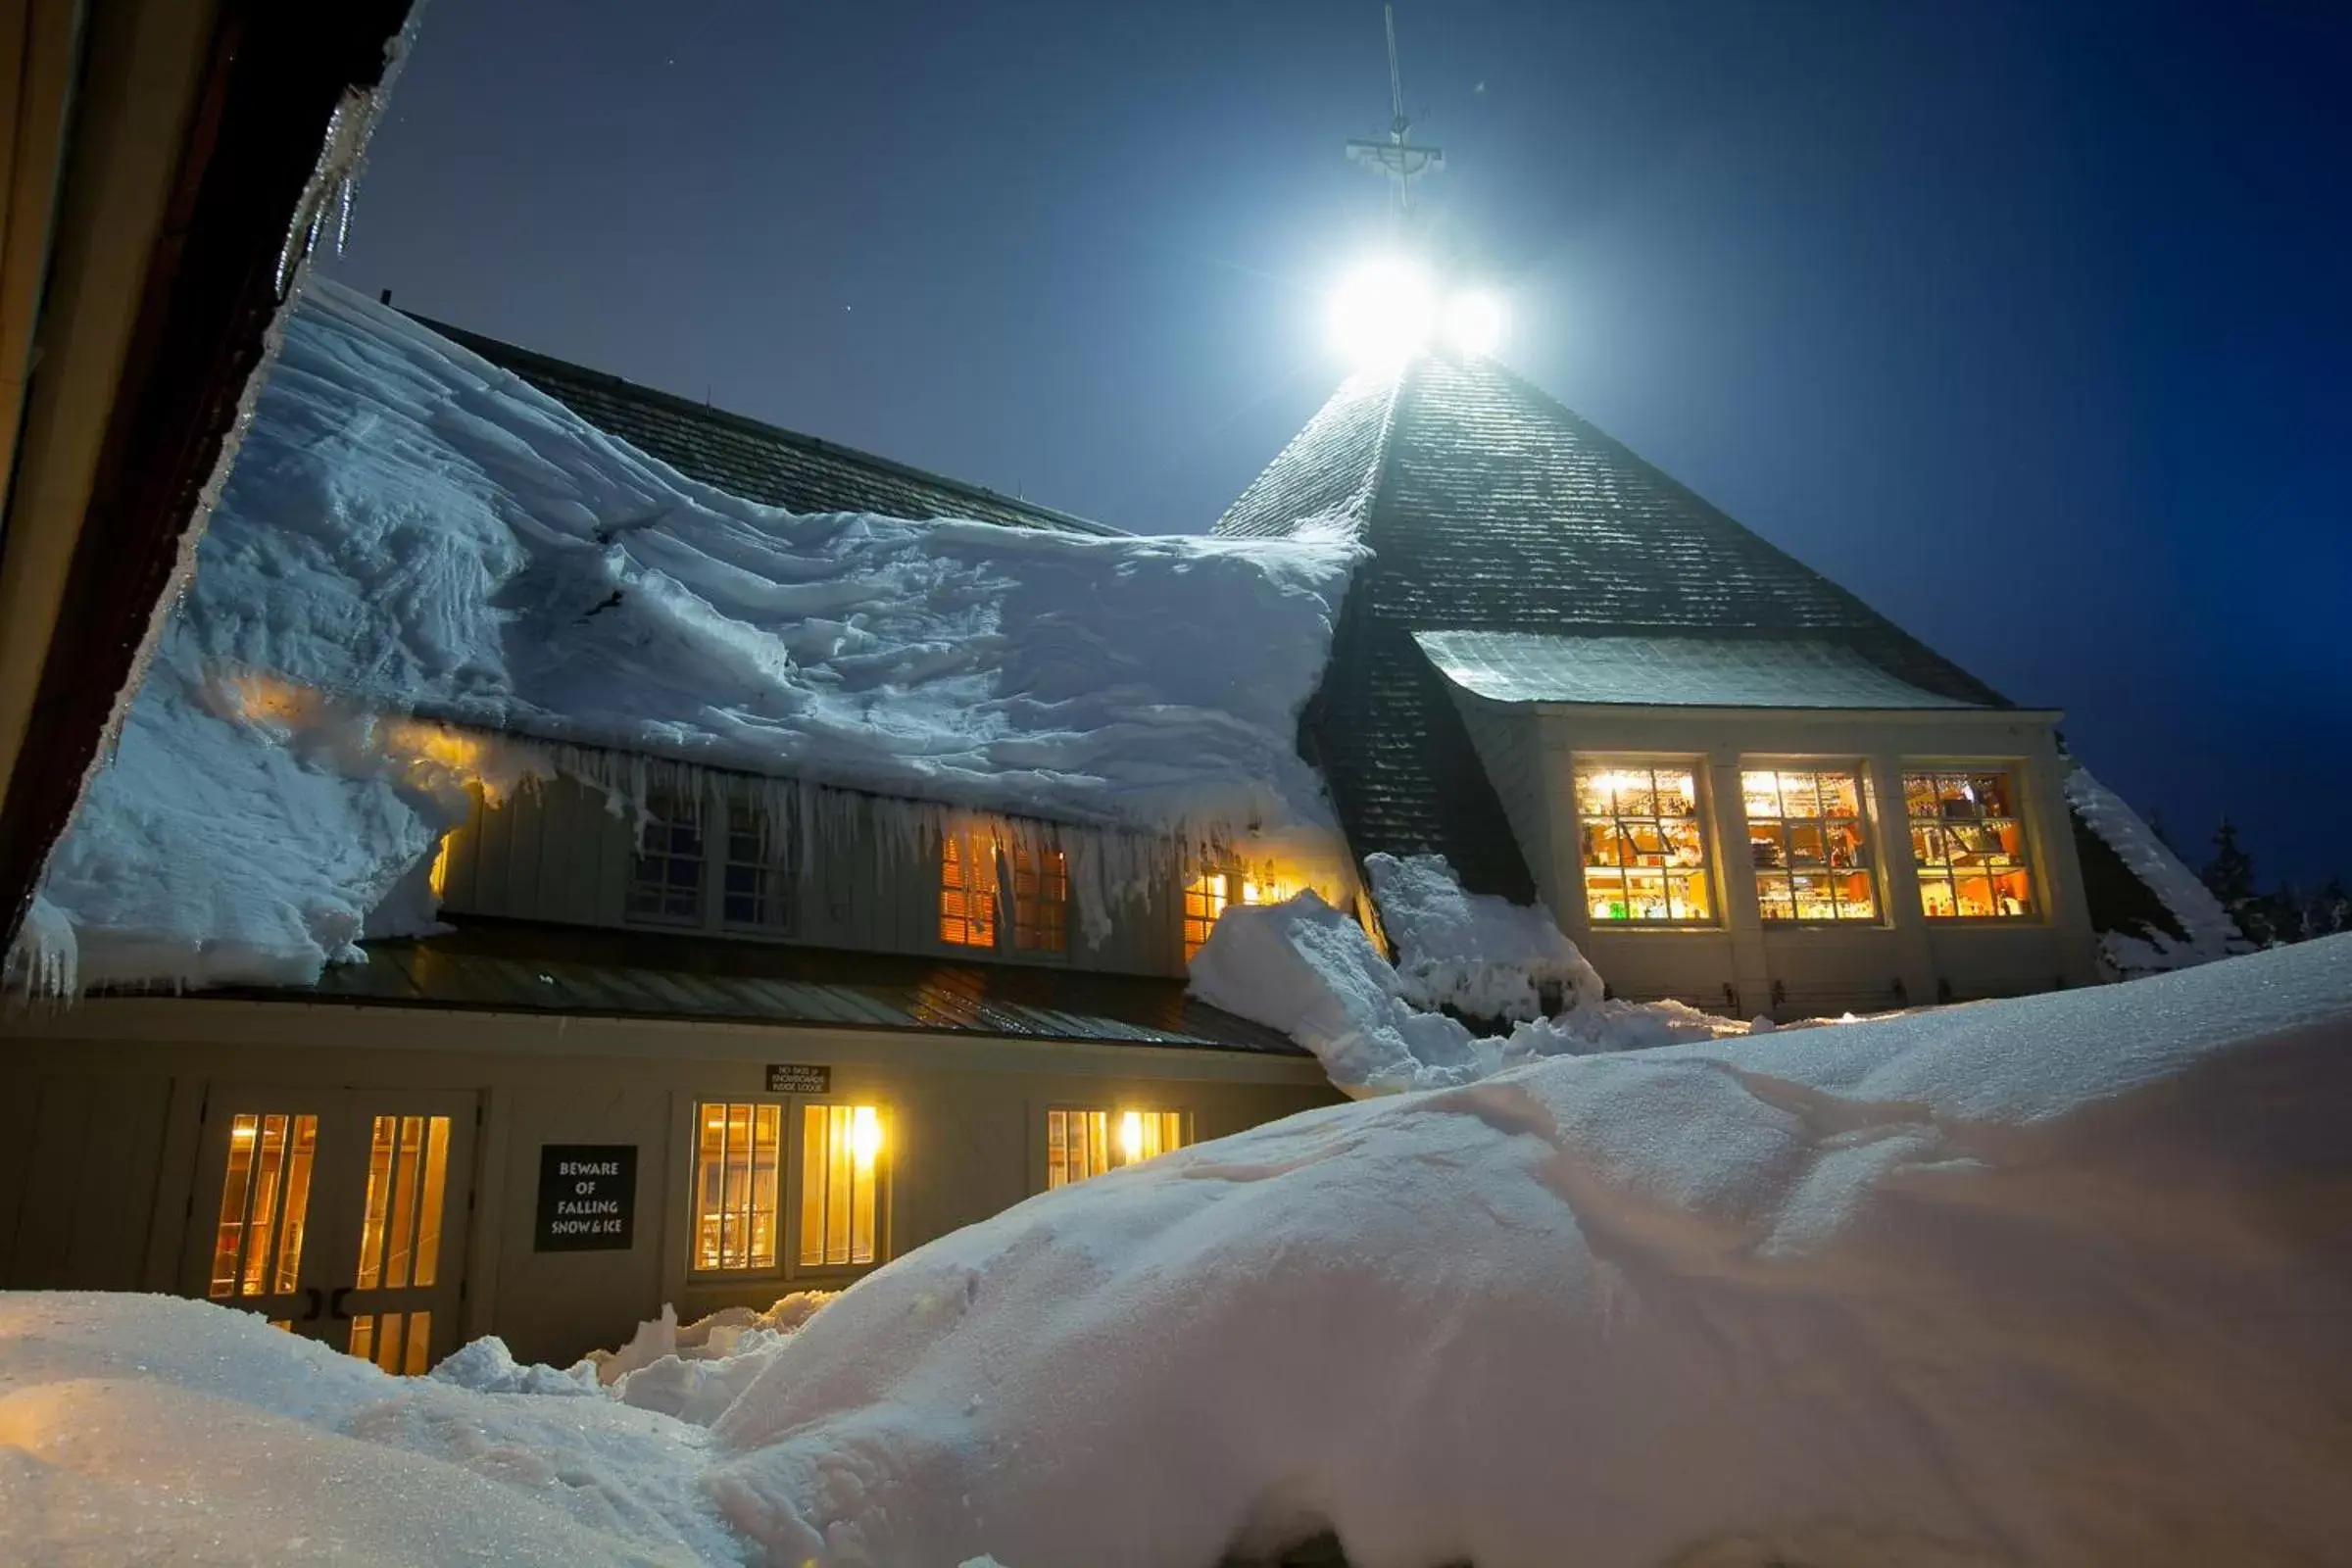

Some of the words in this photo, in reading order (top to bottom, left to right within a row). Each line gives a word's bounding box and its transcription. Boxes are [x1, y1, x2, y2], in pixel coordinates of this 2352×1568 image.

[560, 1161, 619, 1176] BEWARE
[575, 1181, 596, 1195] OF
[558, 1200, 618, 1215] FALLING
[551, 1220, 591, 1235] SNOW
[591, 1219, 602, 1234] &
[603, 1219, 622, 1234] ICE
